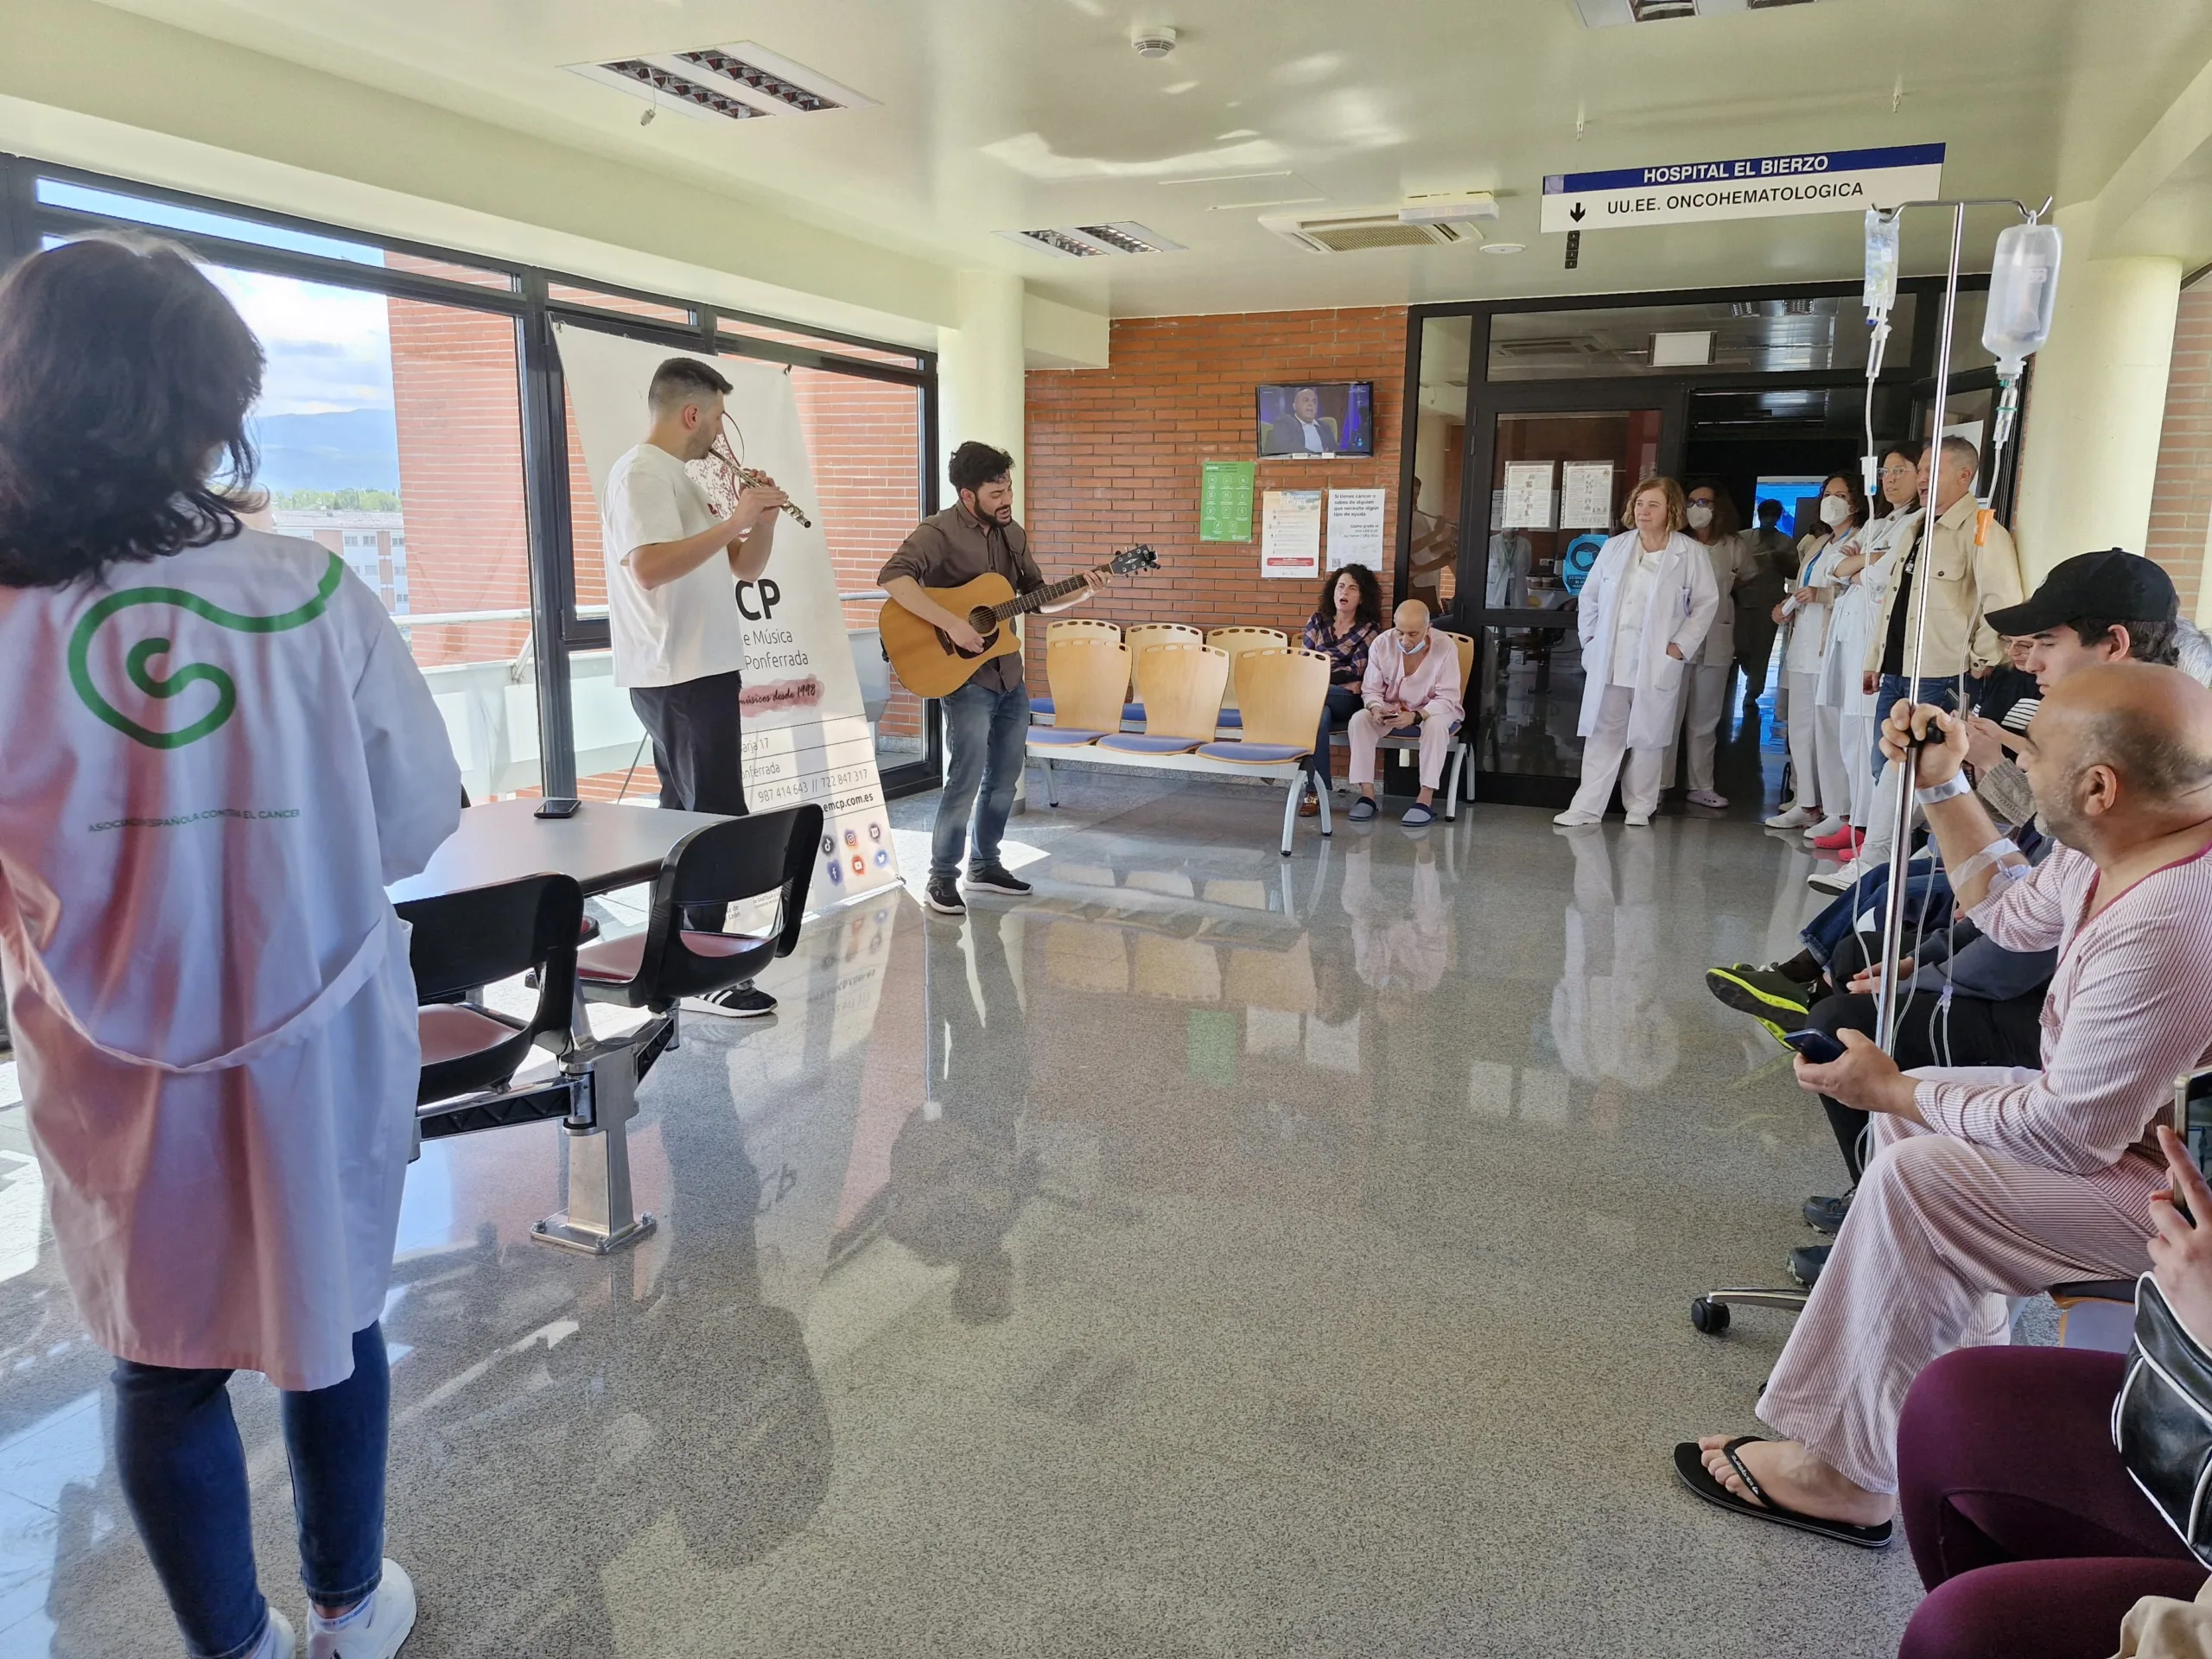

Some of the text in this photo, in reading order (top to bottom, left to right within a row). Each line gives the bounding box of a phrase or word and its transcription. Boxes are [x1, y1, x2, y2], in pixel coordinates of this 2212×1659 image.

[1643, 155, 1828, 183] HOSPITAL EL BIERZO
[1607, 181, 1864, 214] UU.EE. ONCOHEMATOLOGICA
[742, 628, 793, 646] e Música
[744, 650, 809, 671] Ponferrada
[772, 689, 795, 702] desde
[797, 683, 817, 698] 1998
[741, 737, 769, 754] arja 17
[758, 788, 774, 803] 987
[776, 785, 792, 799] 414
[793, 781, 809, 795] 643
[821, 775, 837, 788] 722
[837, 772, 852, 785] 847
[853, 768, 868, 782] 317
[244, 810, 256, 819] EL
